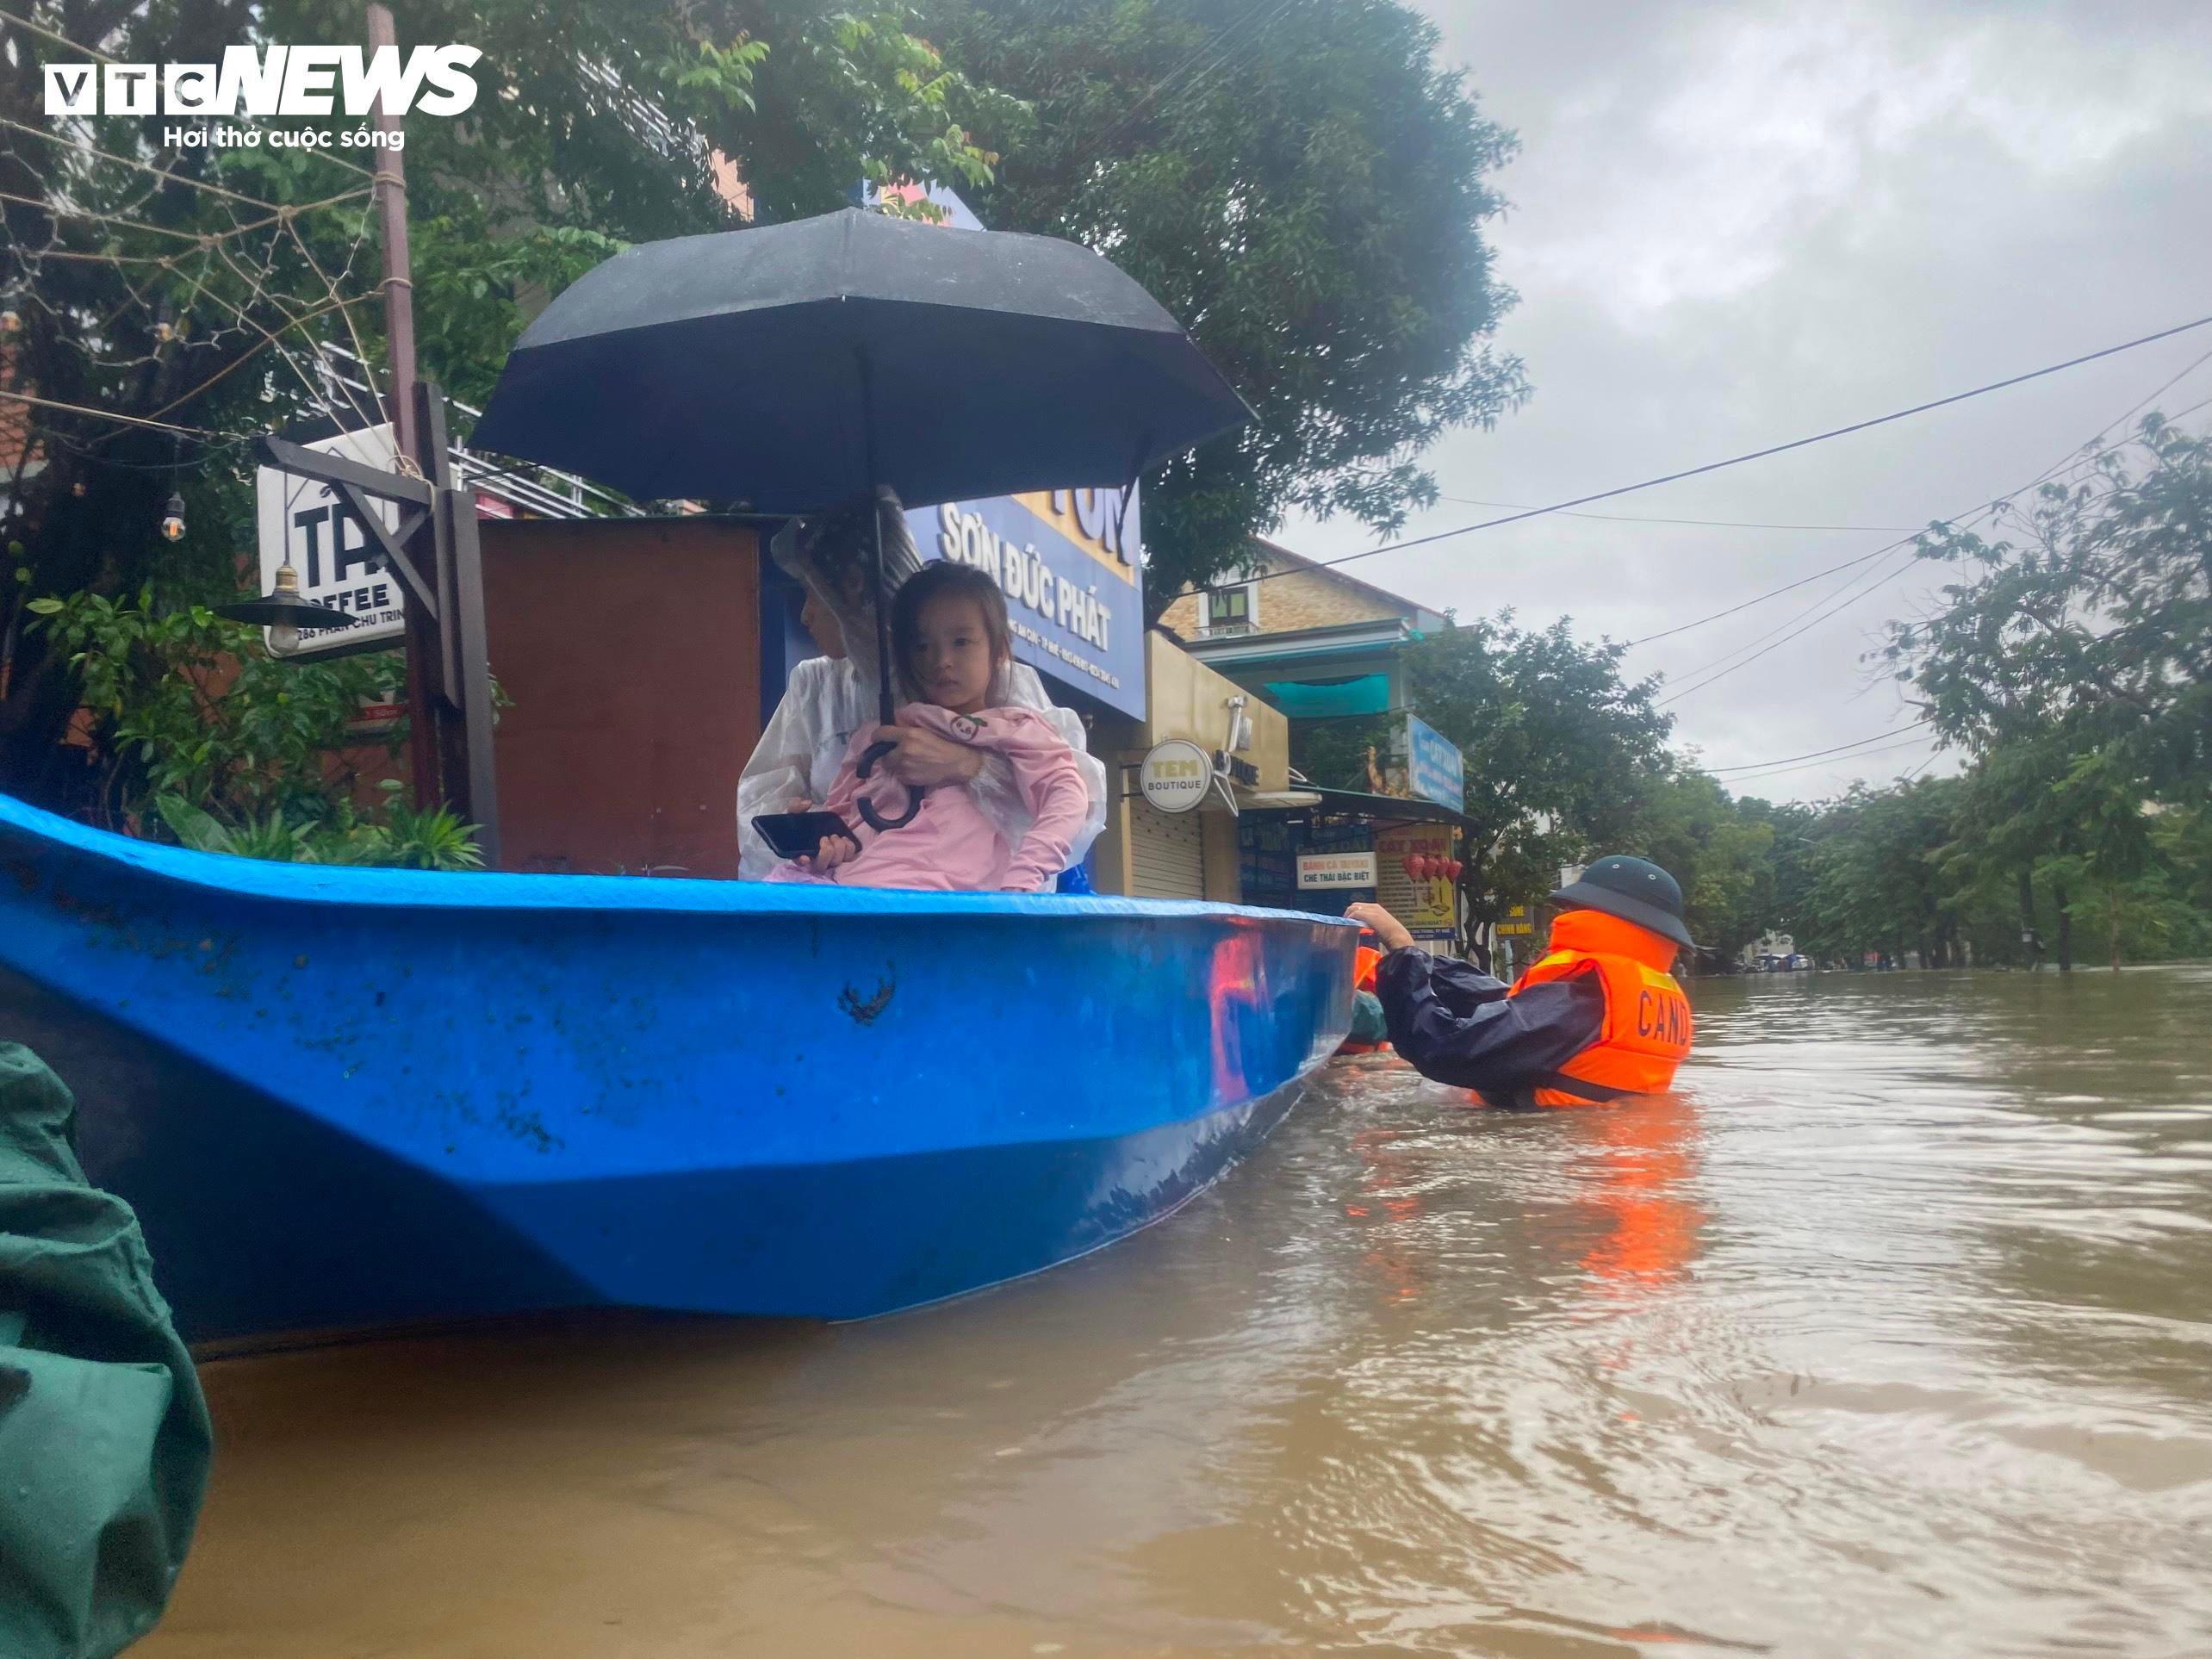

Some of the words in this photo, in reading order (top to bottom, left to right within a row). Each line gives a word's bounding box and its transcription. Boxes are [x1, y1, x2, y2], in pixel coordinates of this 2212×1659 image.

[1004, 538, 1055, 619] ĐỨC
[1057, 576, 1112, 652] PHÁT
[298, 627, 315, 641] 286
[352, 613, 377, 628] CHU
[1147, 779, 1202, 791] BOUTIQUE
[1320, 870, 1335, 882] THÁI
[1354, 870, 1369, 881] BIỆT
[1638, 991, 1688, 1047] CAND
